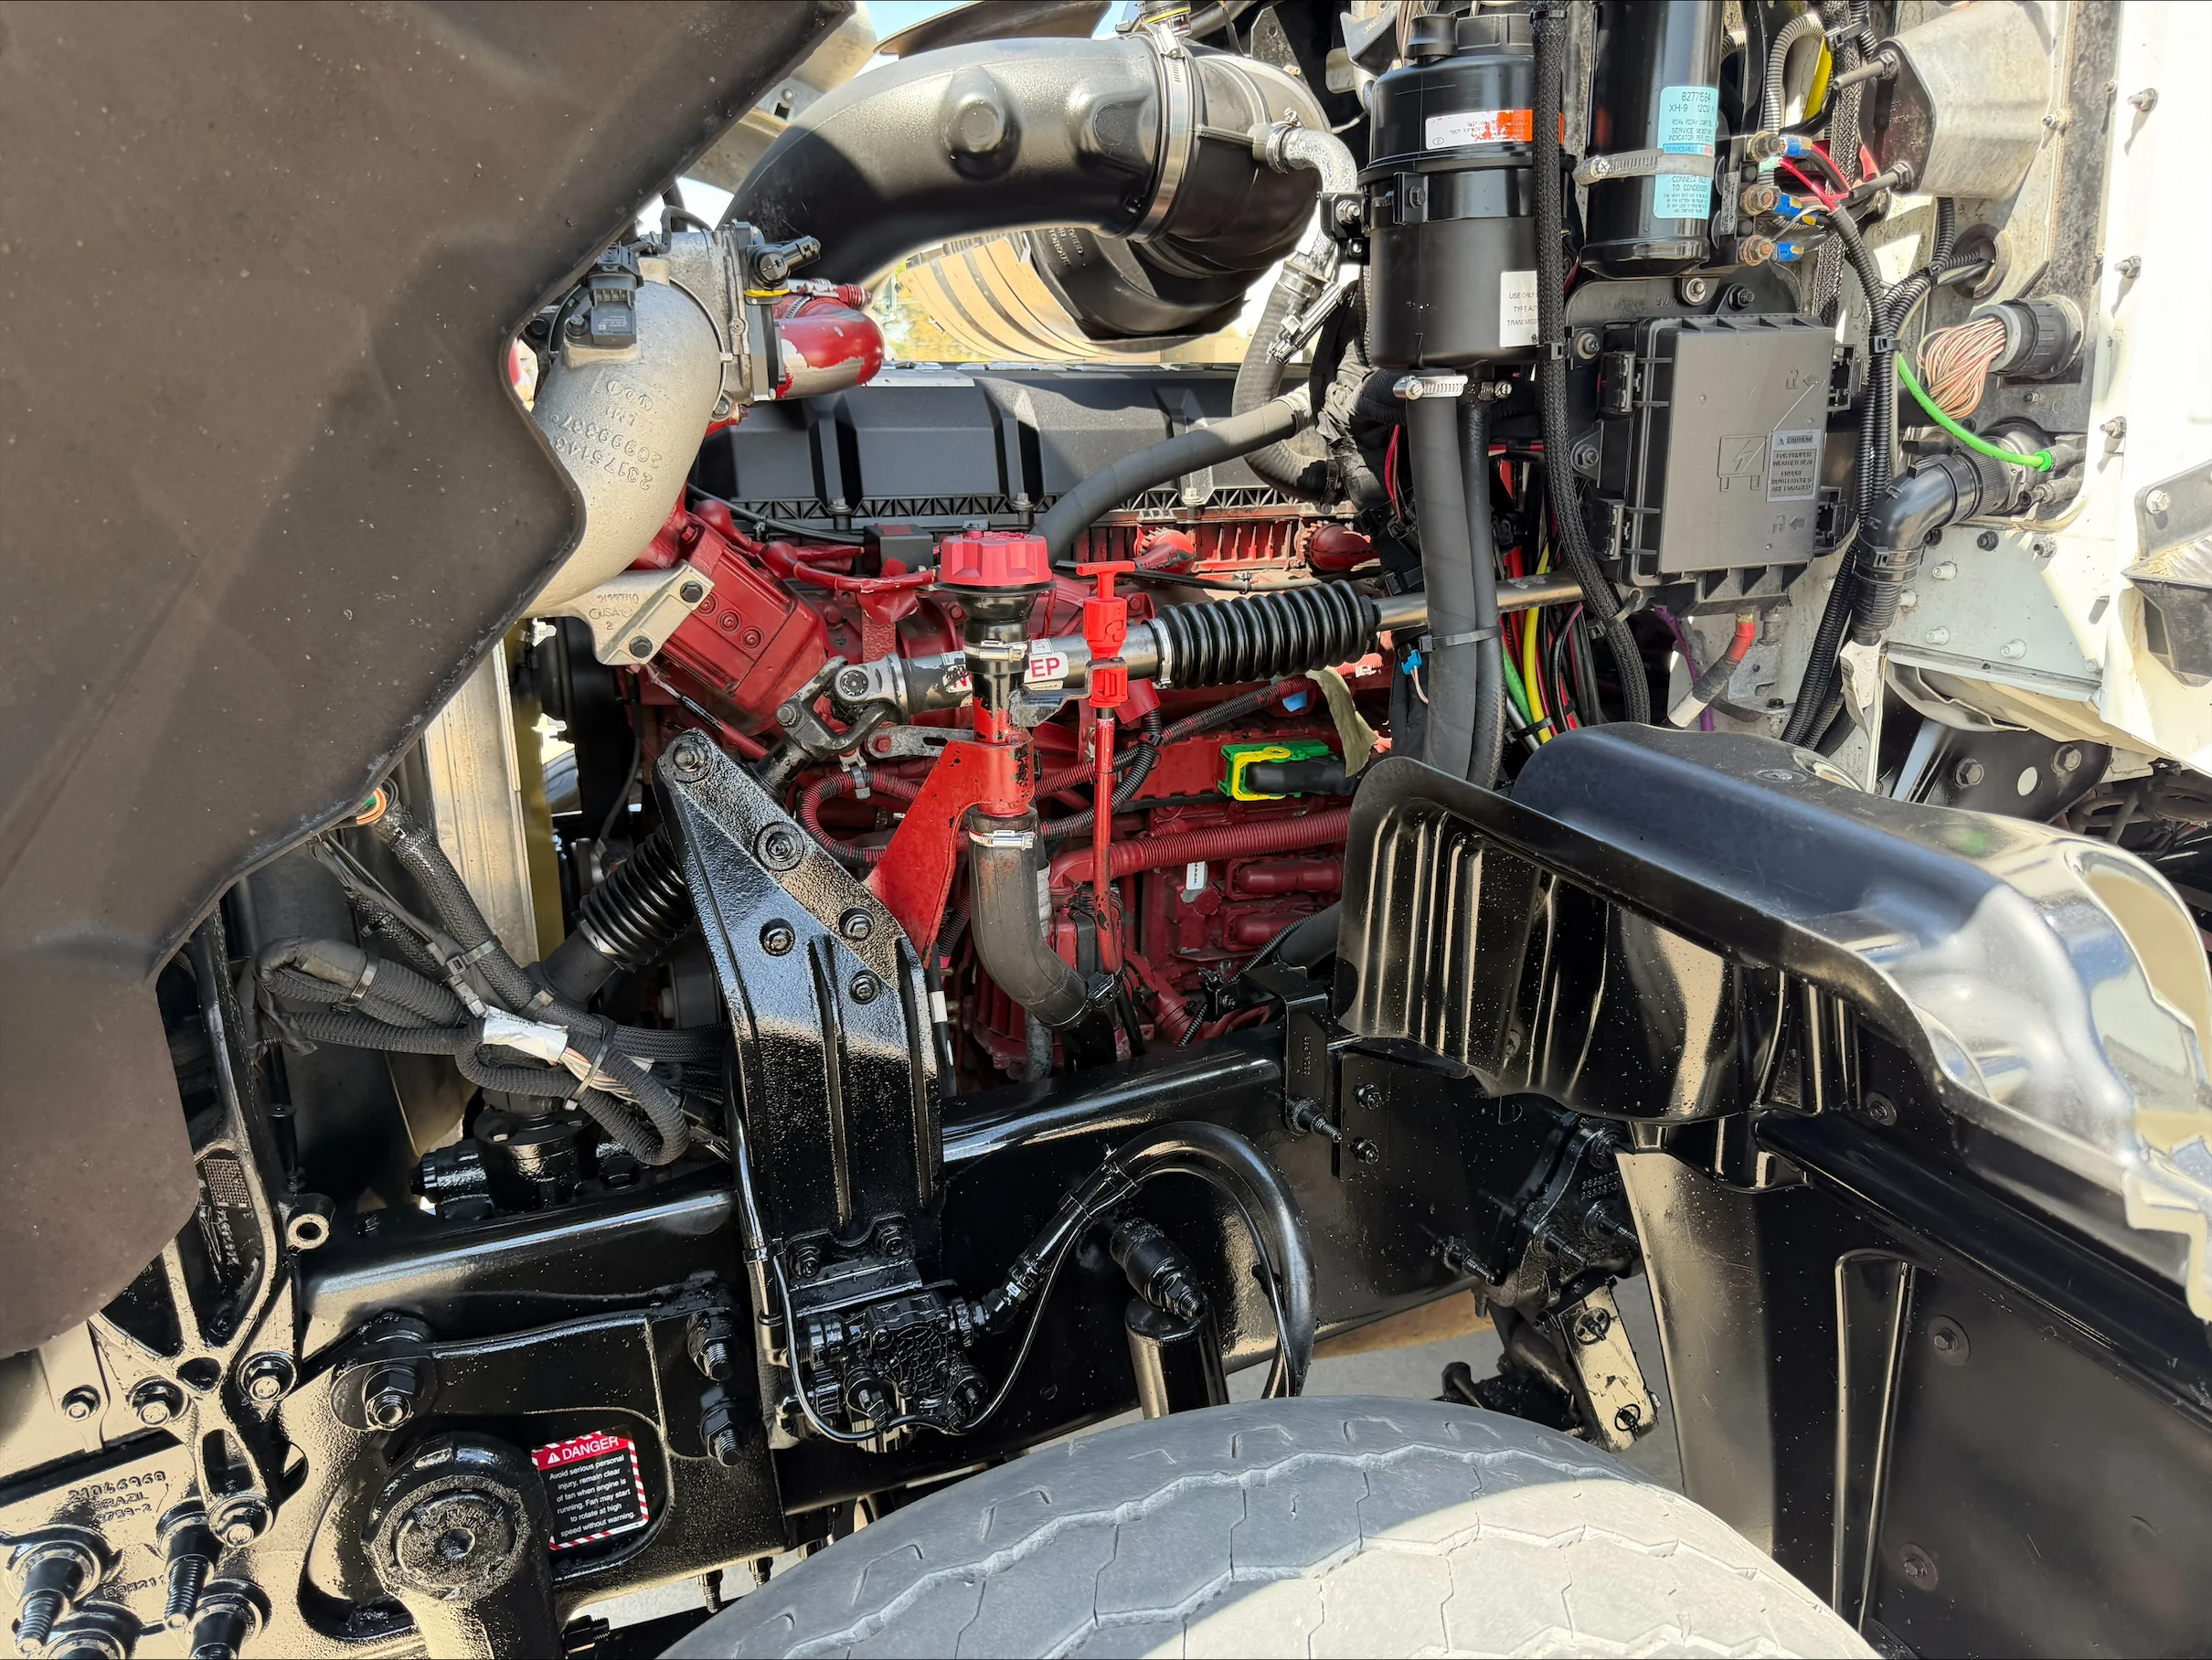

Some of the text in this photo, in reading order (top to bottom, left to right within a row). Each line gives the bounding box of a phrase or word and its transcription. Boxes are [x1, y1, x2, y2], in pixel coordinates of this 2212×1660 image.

[1669, 103, 1688, 112] XH-9
[1668, 133, 1694, 142] INDICATOR
[1508, 292, 1521, 300] USE
[561, 1436, 620, 1461] DANGER
[548, 1454, 625, 1481] Avoid serious personal
[558, 1467, 622, 1491] injury, remain clear
[556, 1477, 627, 1503] of fan when engine is
[557, 1488, 631, 1515] running. Fan may start
[560, 1526, 582, 1538] speed
[582, 1519, 607, 1531] without
[607, 1511, 636, 1525] warning.
[569, 1503, 622, 1523] to rotate at high
